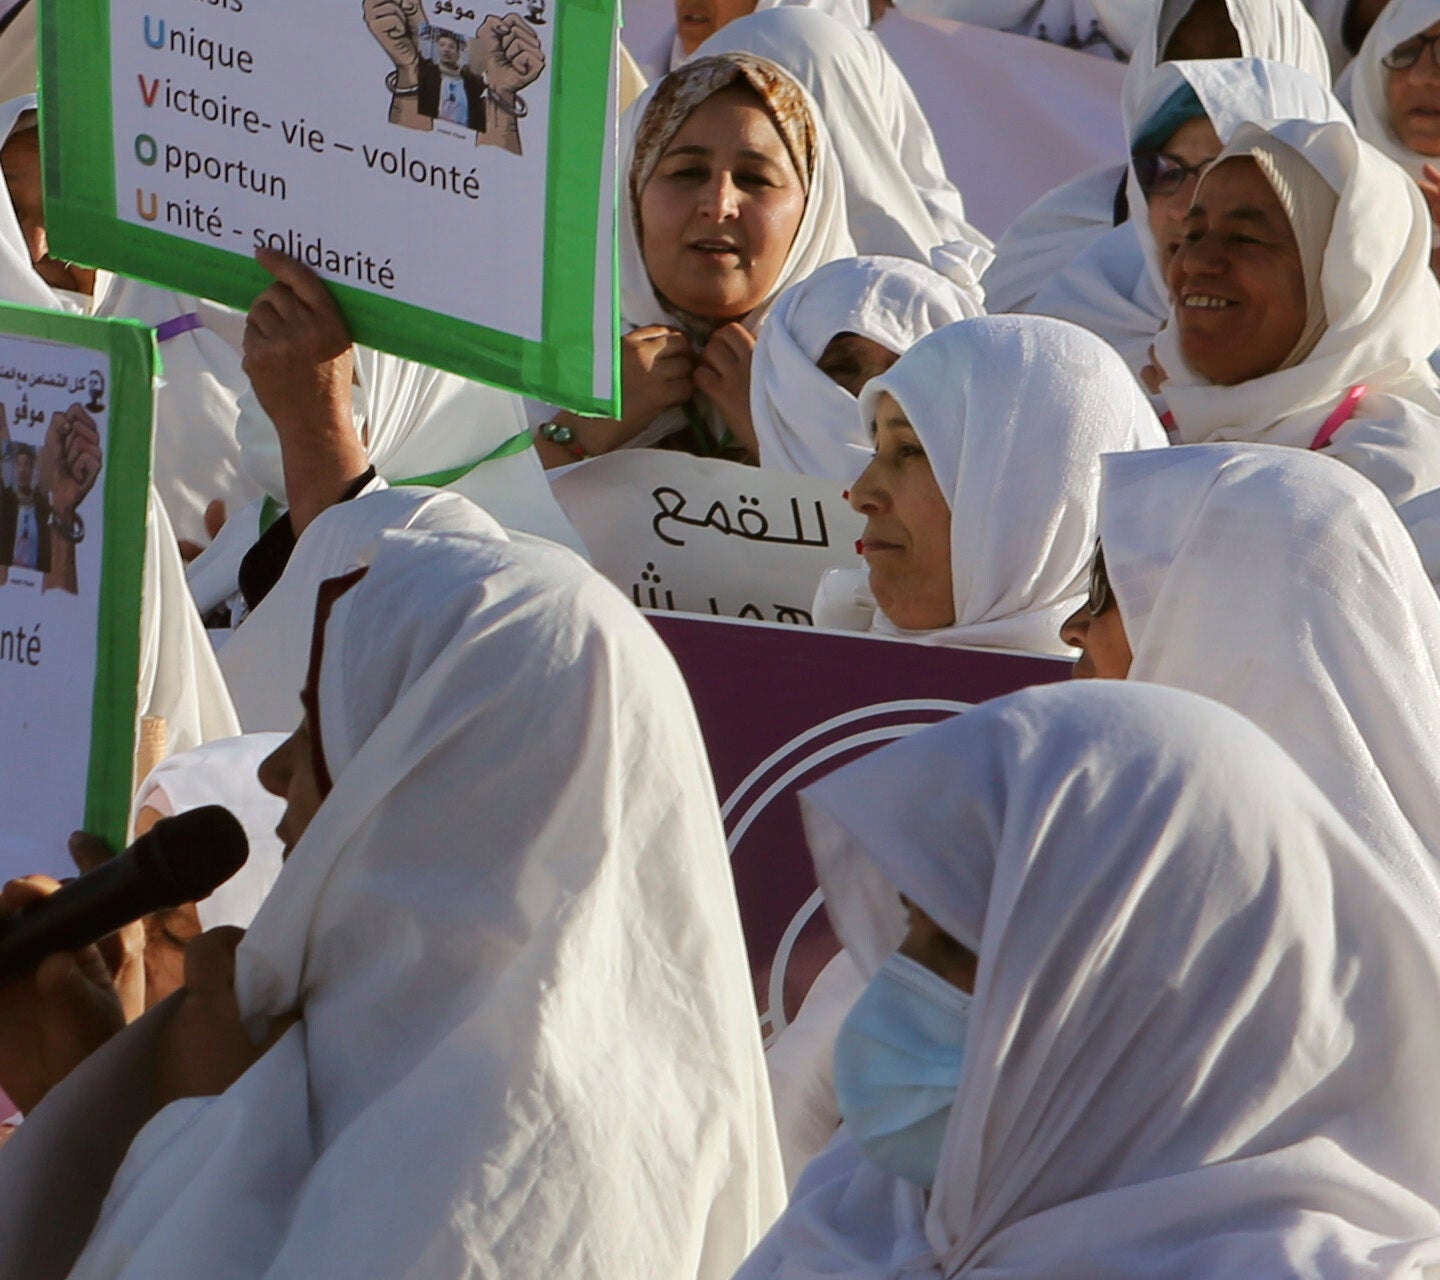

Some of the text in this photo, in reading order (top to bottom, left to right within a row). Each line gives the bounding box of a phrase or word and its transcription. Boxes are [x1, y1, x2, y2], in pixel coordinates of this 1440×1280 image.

[144, 14, 254, 74] Unique
[281, 118, 325, 153] vie
[363, 144, 481, 200] volonté
[253, 226, 395, 290] solidarité
[652, 486, 829, 547] للقمع
